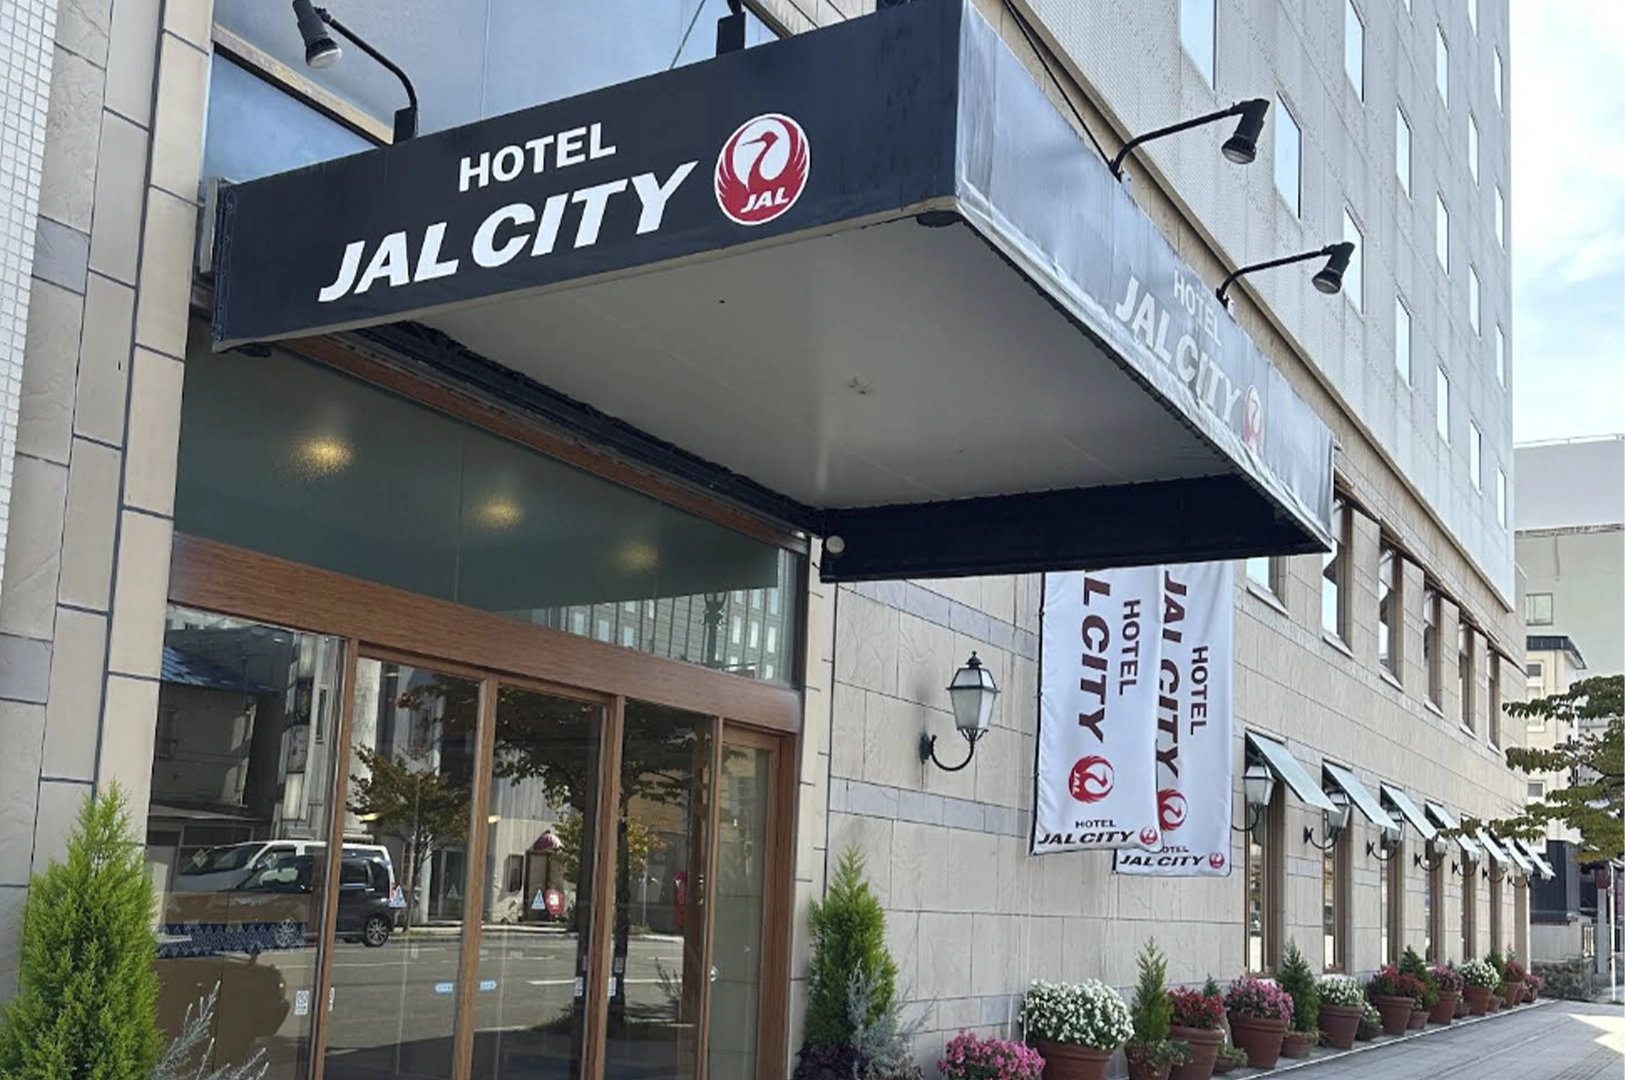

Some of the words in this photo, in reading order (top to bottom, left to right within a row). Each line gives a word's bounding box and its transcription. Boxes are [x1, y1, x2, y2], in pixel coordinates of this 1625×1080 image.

[459, 122, 616, 192] HOTEL
[318, 222, 459, 302] JAL
[471, 160, 699, 268] CITY
[740, 187, 790, 213] JAL
[1173, 269, 1222, 347] HOTEL
[1114, 275, 1172, 365] JAL
[1176, 334, 1241, 422] CITY
[1079, 615, 1110, 743] CITY
[1119, 599, 1141, 696] HOTEL
[1156, 658, 1180, 779] CITY
[1191, 646, 1208, 735] HOTEL
[1072, 770, 1081, 795] JAL
[1037, 833, 1076, 845] JAL
[1080, 831, 1135, 845] CITY
[1075, 819, 1117, 829] HOTEL
[1119, 855, 1154, 867] JAL
[1157, 855, 1205, 867] CITY
[1160, 846, 1190, 854] OTEL
